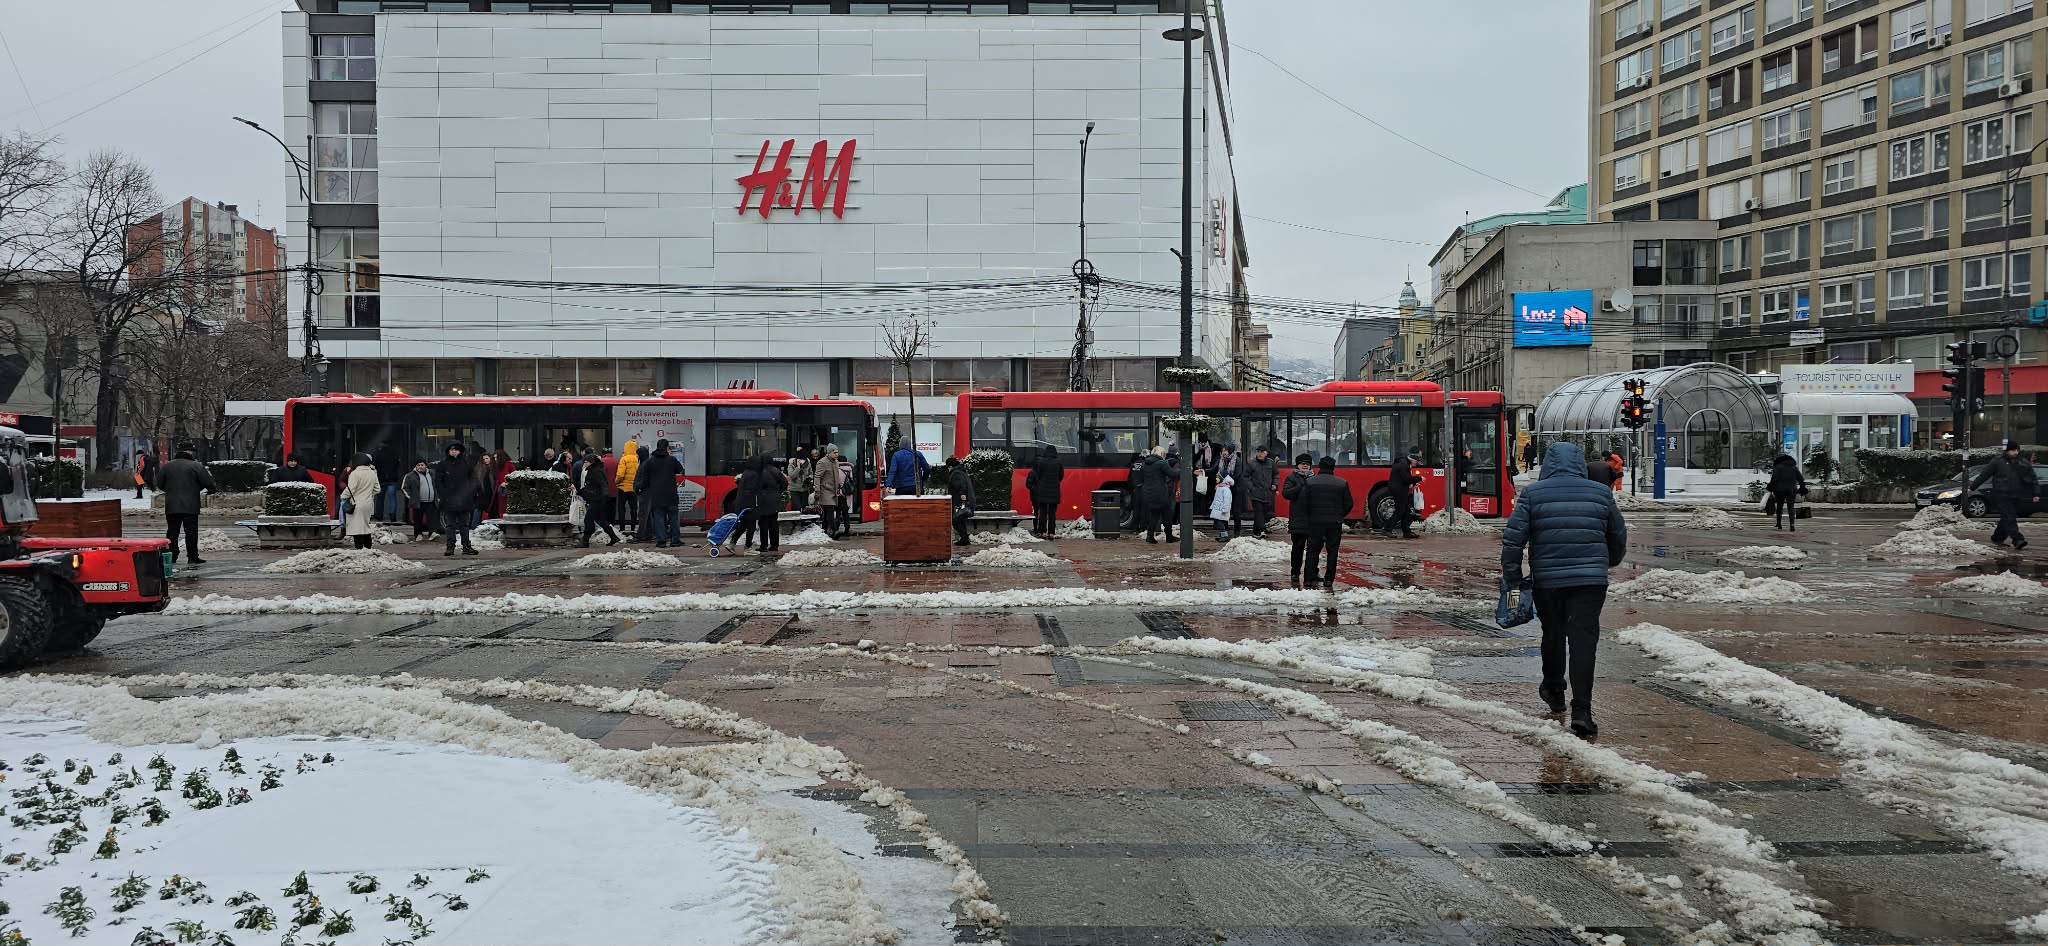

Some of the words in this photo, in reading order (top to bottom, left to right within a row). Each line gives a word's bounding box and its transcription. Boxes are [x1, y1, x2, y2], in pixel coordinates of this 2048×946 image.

[737, 139, 857, 219] H&M
[1795, 373, 1837, 382] TOURIST
[1839, 373, 1862, 382] INFO
[1865, 373, 1902, 382] CENTER
[626, 418, 650, 426] protiv
